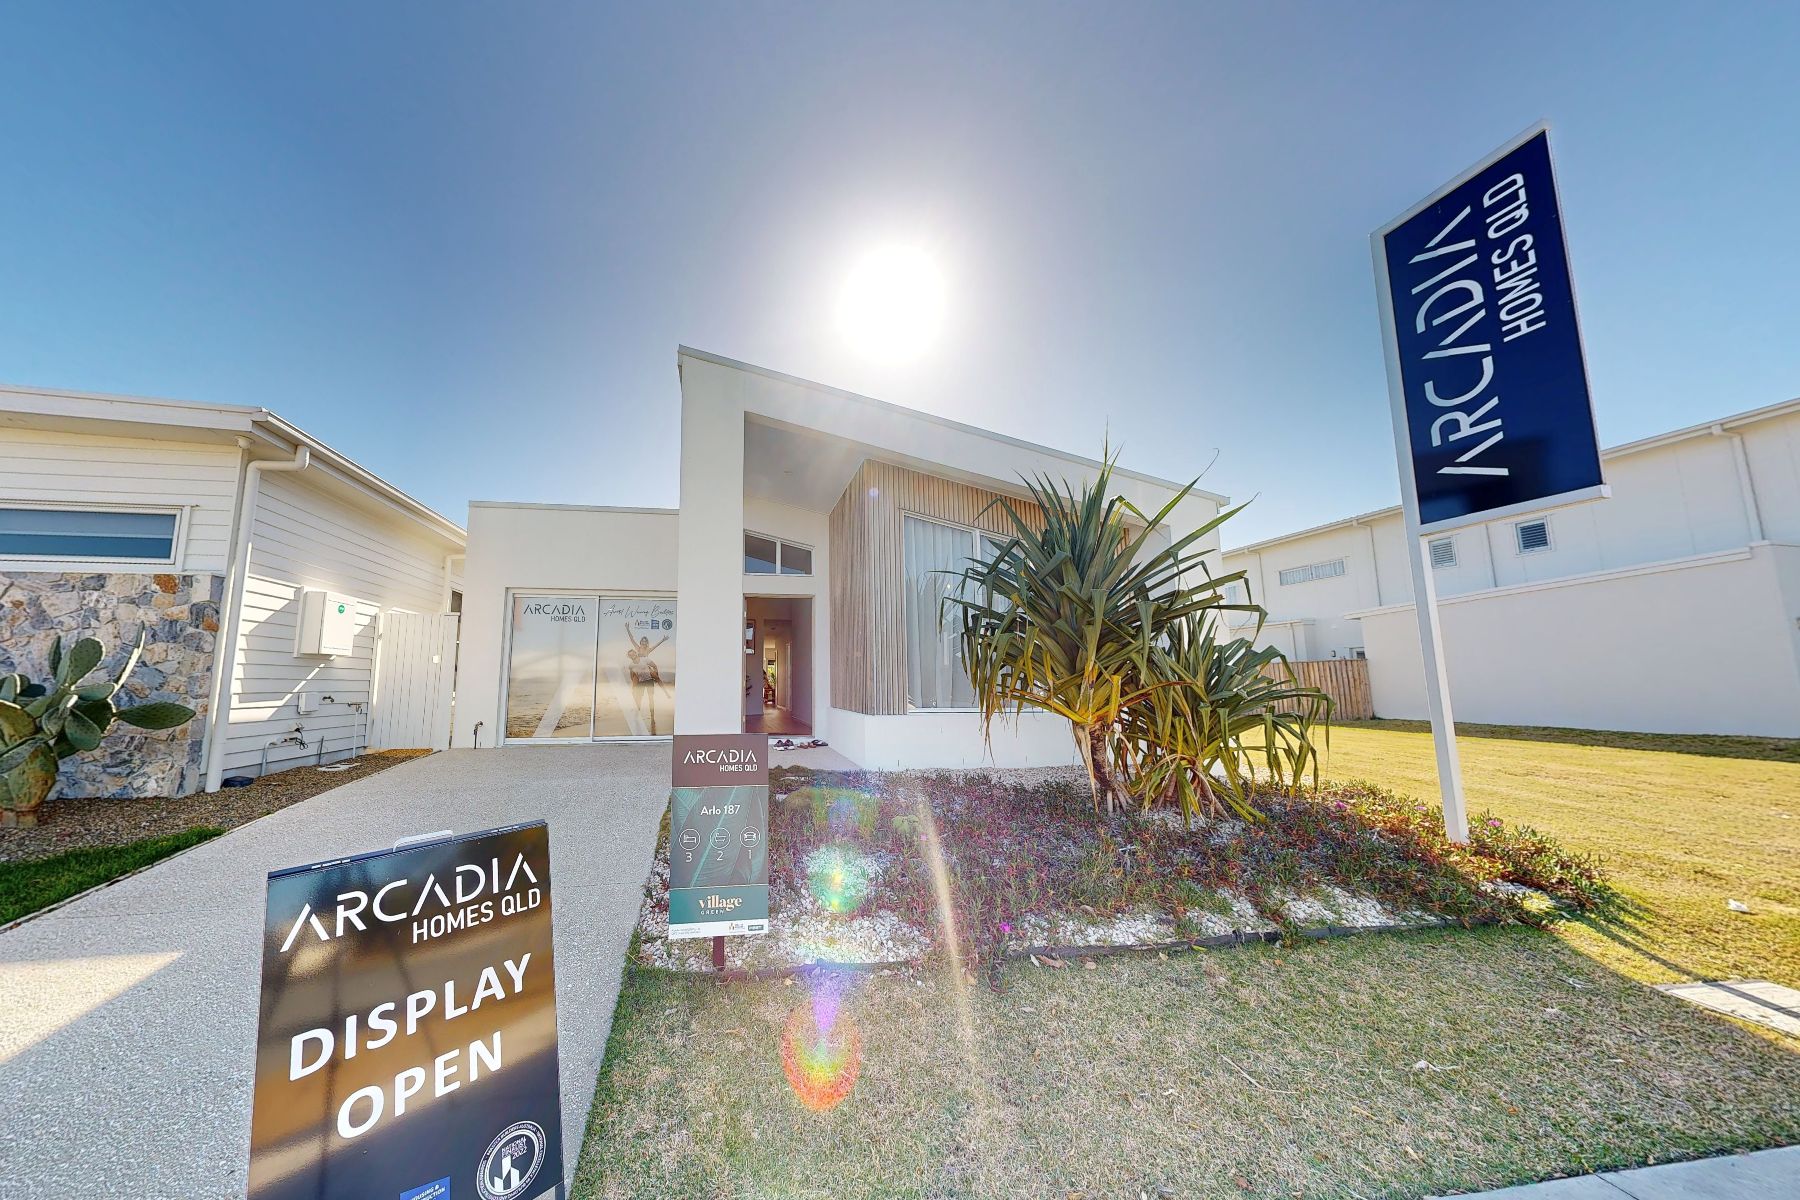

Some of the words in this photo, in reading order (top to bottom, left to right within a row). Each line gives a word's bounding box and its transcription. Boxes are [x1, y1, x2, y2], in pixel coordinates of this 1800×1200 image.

[1483, 172, 1530, 240] QLD
[1491, 233, 1547, 343] HOMES
[1408, 205, 1510, 476] ARCADIA
[523, 603, 585, 615] ARCADIA
[550, 615, 572, 623] HOMES
[683, 749, 758, 764] ARCADIA
[719, 764, 743, 772] HOMES
[744, 764, 758, 772] QLD
[700, 805, 722, 816] Arlo
[723, 804, 741, 815] 187
[685, 851, 693, 863] 3
[716, 850, 724, 861] 2
[279, 852, 538, 953] ARCADIA
[412, 900, 494, 944] HOMES
[501, 887, 541, 914] QLD
[698, 894, 743, 912] village
[289, 952, 532, 1082] DISPLAY
[336, 1030, 501, 1139] OPEN
